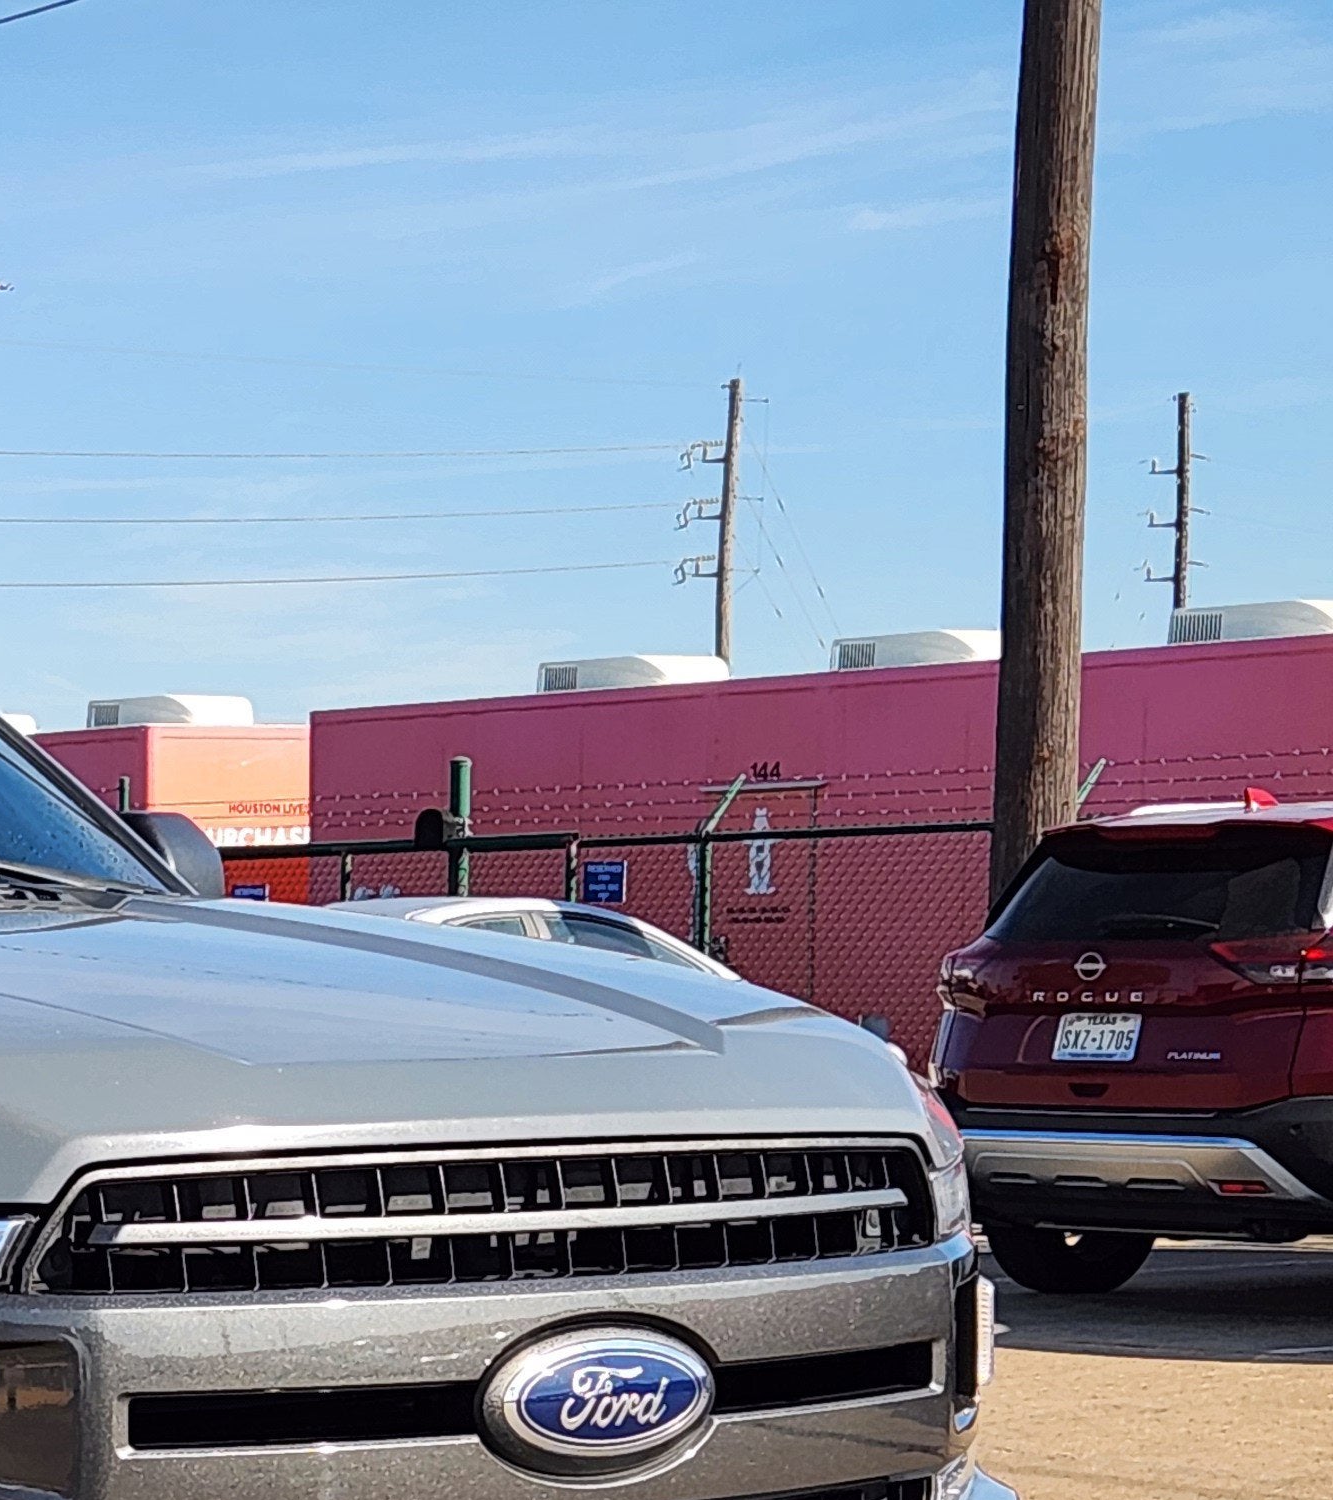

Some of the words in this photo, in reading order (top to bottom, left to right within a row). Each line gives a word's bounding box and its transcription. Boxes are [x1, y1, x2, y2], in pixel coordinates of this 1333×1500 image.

[749, 761, 781, 780] 144
[228, 803, 281, 814] HOUSTON
[205, 826, 310, 847] URCHAS
[1032, 991, 1143, 1002] ROGUE
[1087, 1015, 1118, 1026] TEXAS
[1166, 1051, 1221, 1060] PLATINUM
[560, 1364, 670, 1431] Ford
